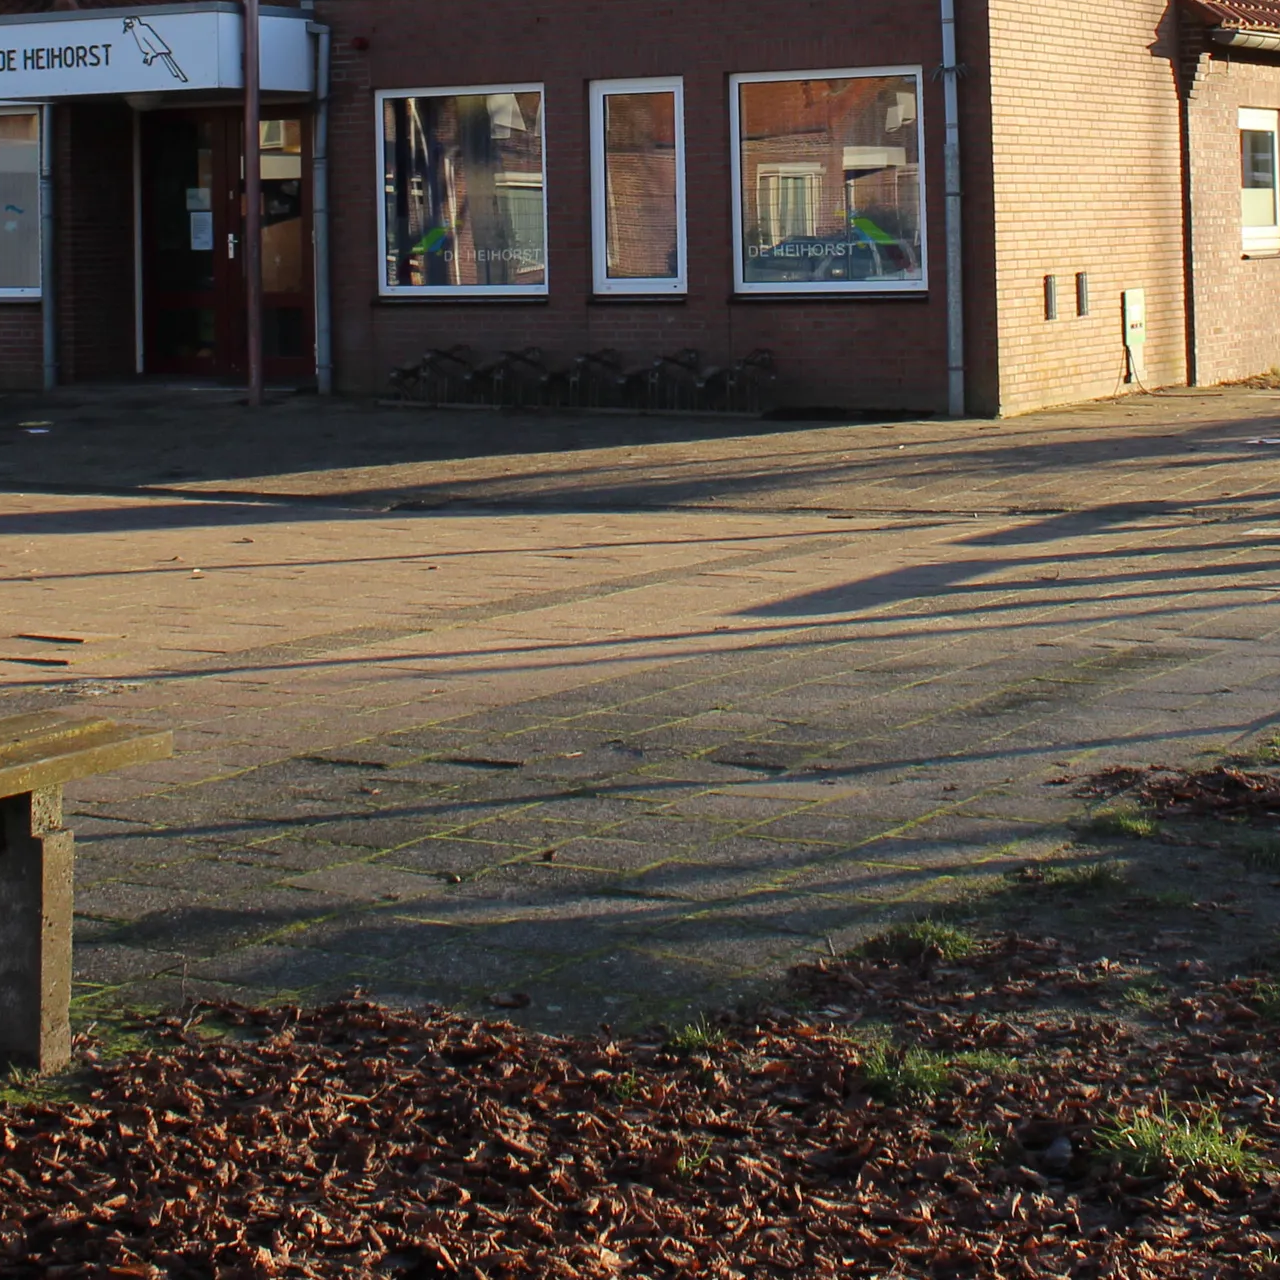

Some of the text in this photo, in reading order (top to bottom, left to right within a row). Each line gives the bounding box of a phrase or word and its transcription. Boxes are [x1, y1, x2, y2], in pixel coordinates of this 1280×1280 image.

[23, 44, 112, 70] HEIHORST
[467, 248, 542, 262] HEIHORST
[748, 243, 856, 258] DE HEIHORST
